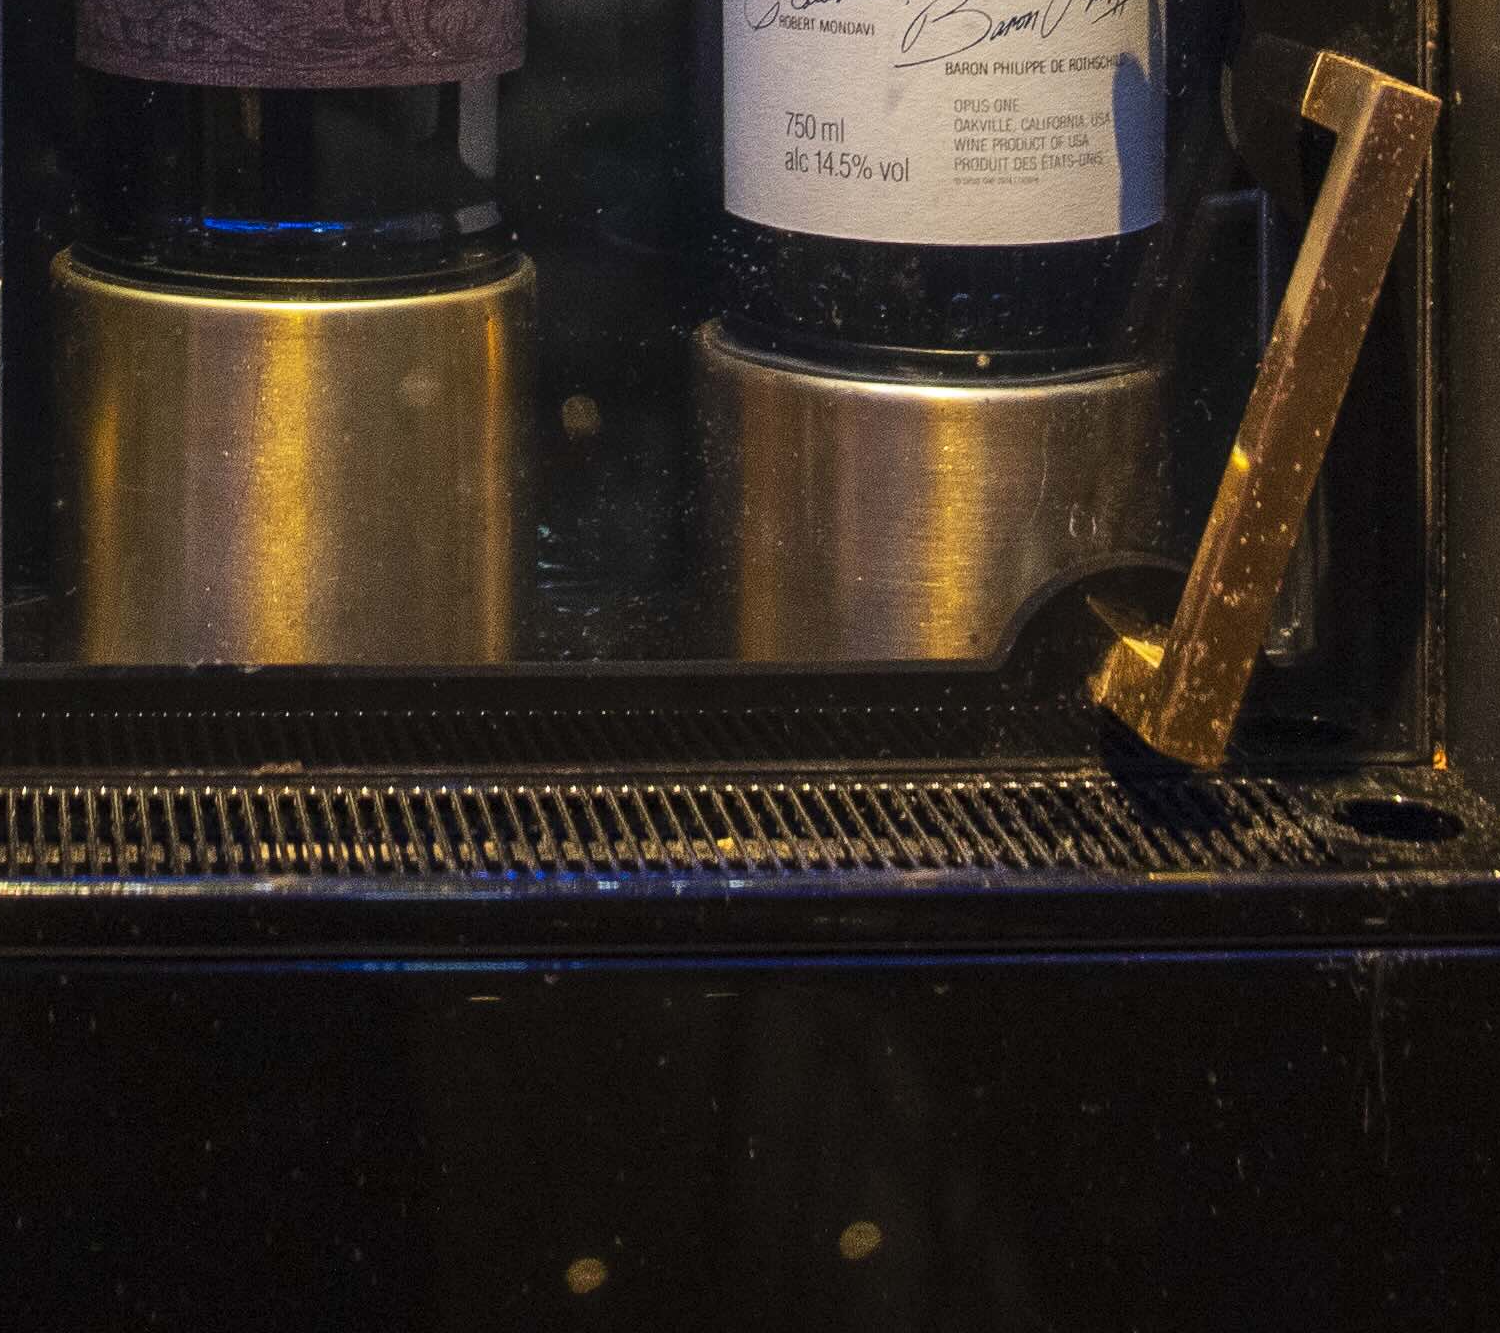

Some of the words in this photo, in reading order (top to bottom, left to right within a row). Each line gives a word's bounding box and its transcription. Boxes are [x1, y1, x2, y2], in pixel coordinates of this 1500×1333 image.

[779, 15, 816, 31] ROBERT
[819, 19, 875, 36] MONDAVI
[945, 61, 988, 76] BARON
[993, 60, 1047, 75] PHILIPPE
[1050, 59, 1065, 73] DE
[953, 98, 990, 114] OPUS
[993, 98, 1020, 113] ONE
[784, 111, 817, 140] 750
[821, 117, 845, 144] ml
[1090, 112, 1111, 127] USA
[953, 137, 988, 152] WINE
[992, 136, 1047, 152] PRODUCT
[1050, 135, 1065, 151] OF
[1068, 134, 1090, 148] USA
[784, 146, 809, 173] alc
[814, 149, 873, 180] 14.5%
[879, 157, 909, 183] vol
[953, 157, 1010, 172] PRODUIT
[1013, 156, 1037, 171] DES
